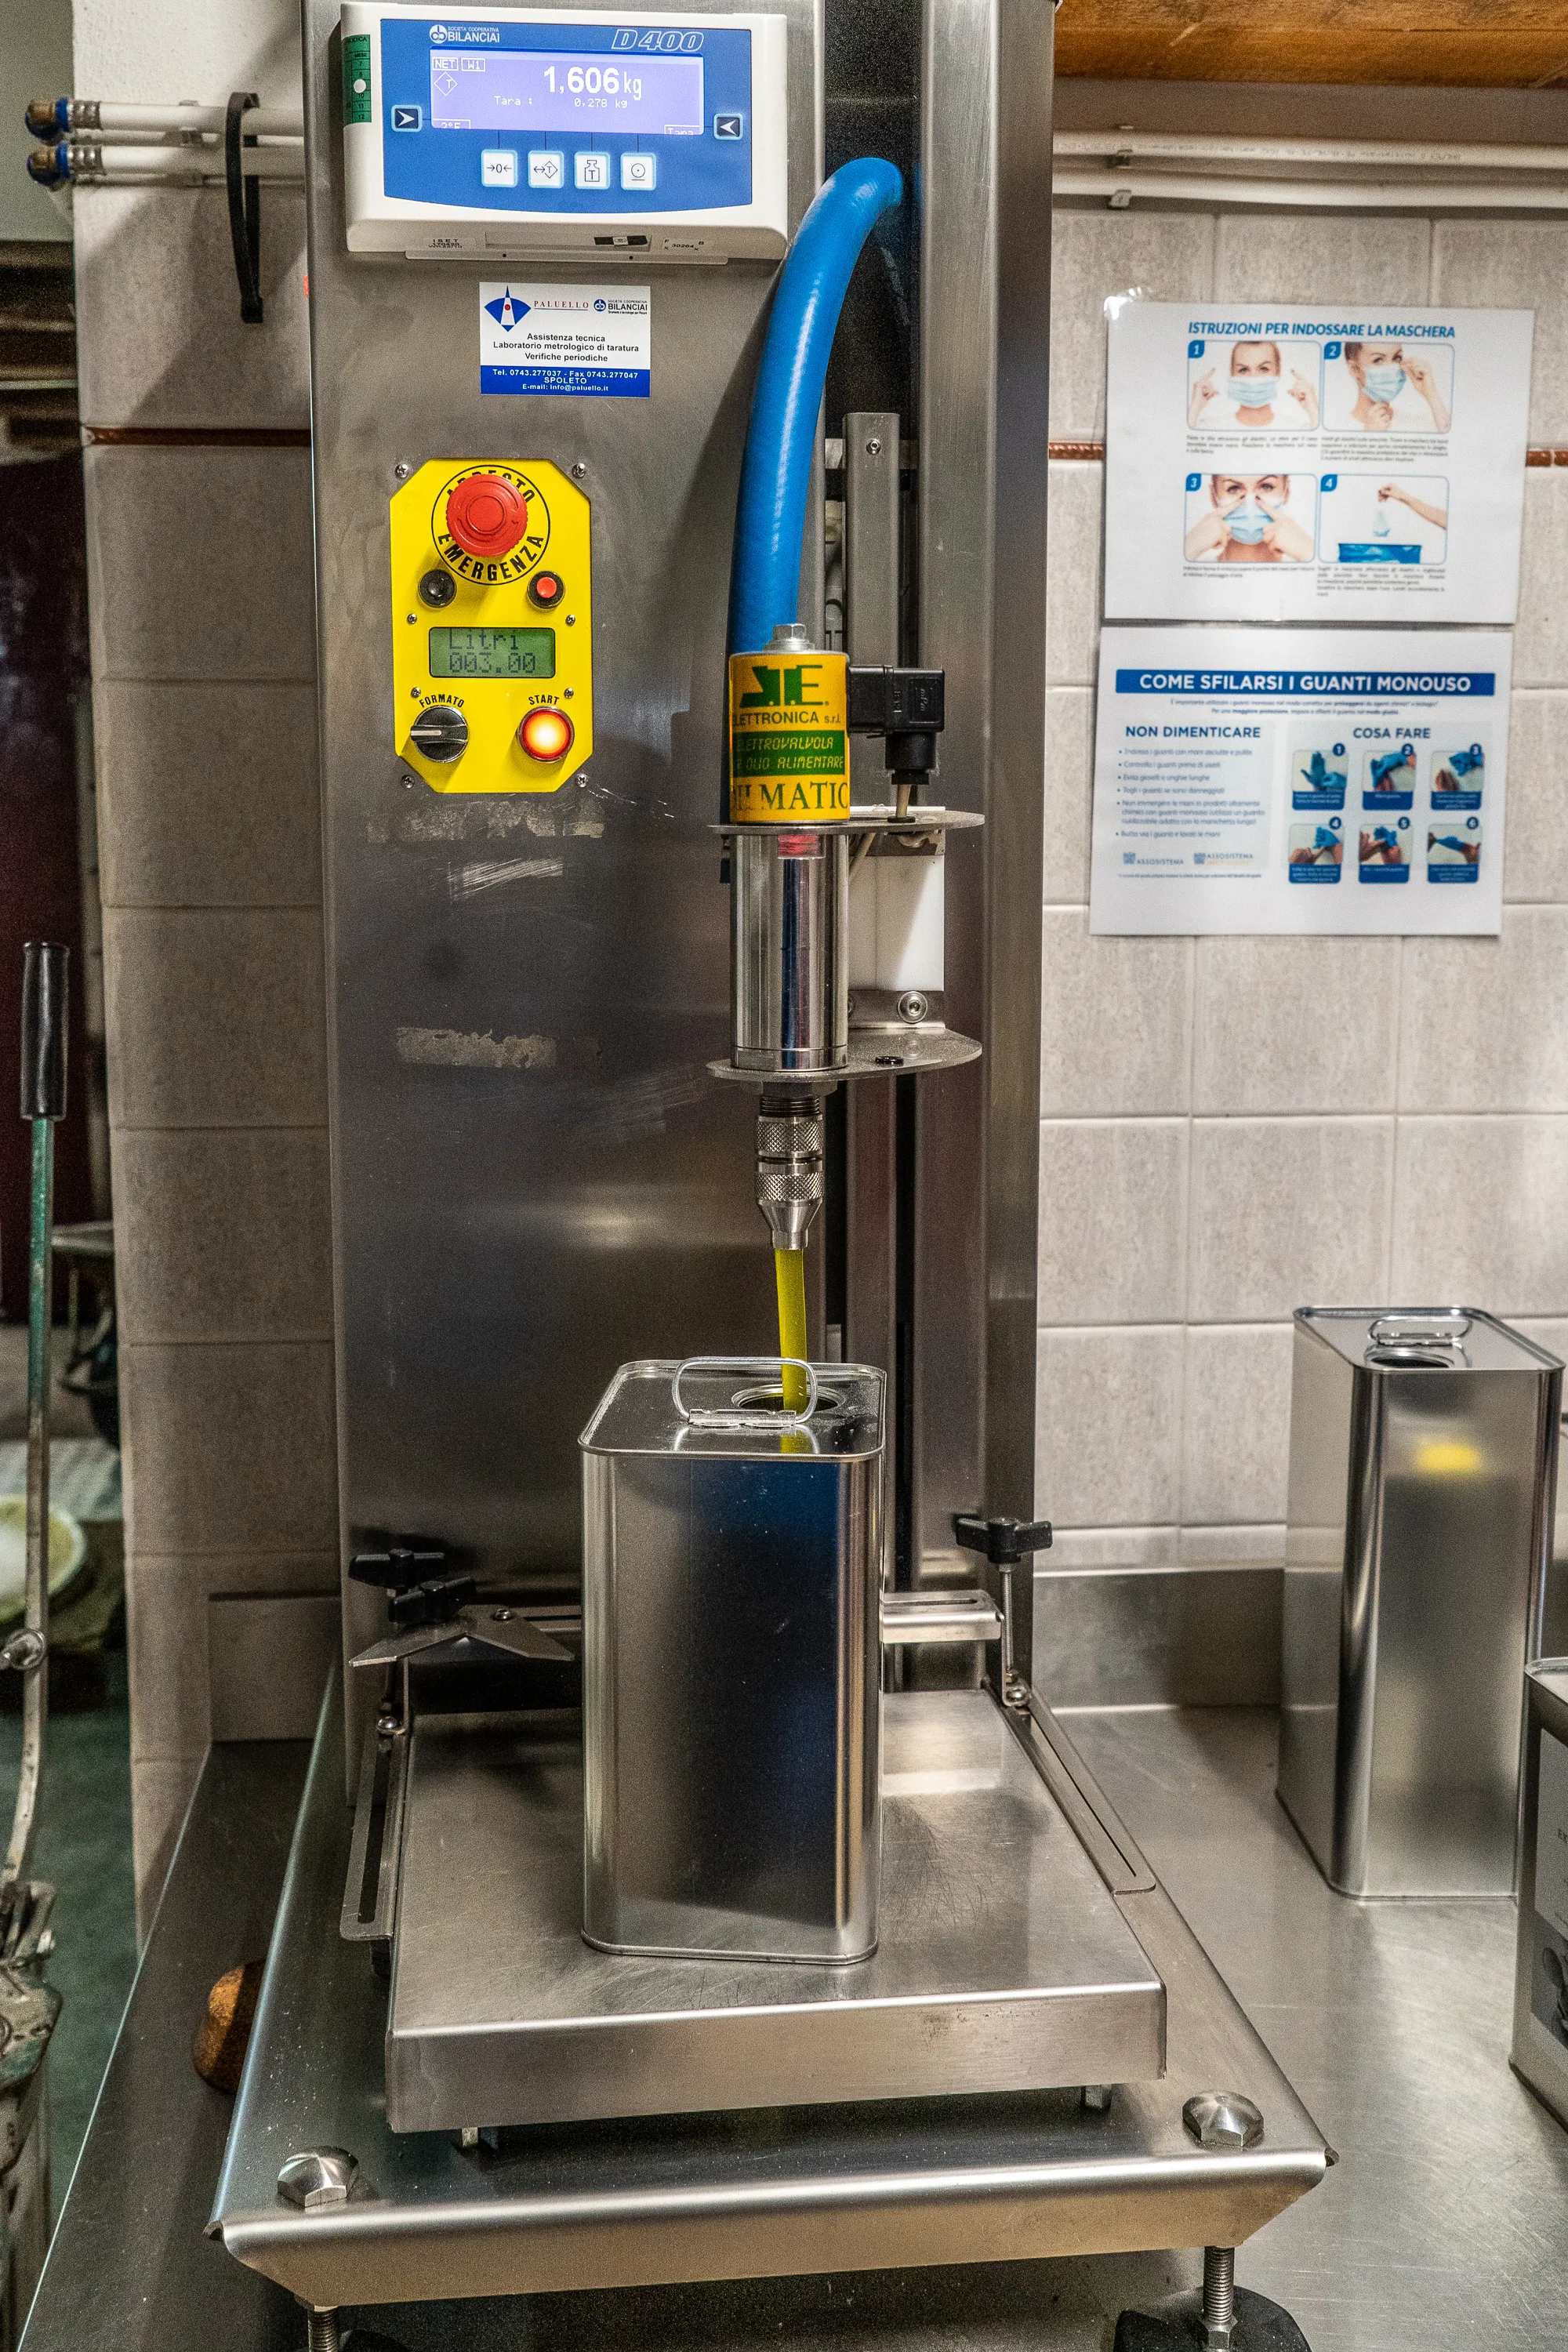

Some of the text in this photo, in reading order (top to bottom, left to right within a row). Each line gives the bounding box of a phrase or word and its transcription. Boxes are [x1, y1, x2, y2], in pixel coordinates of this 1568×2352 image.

[448, 32, 499, 43] BILANCIAI
[435, 59, 456, 69] NET
[467, 60, 481, 69] W1
[543, 65, 642, 100] 1,606 kg
[494, 96, 521, 106] Tara
[574, 98, 608, 108] 0,278
[615, 99, 628, 109] kg
[1188, 321, 1456, 338] ISTRUZIONI PER INDOSSARE LA MASCHERA
[527, 333, 573, 342] Assistenza
[493, 341, 542, 350] Laboratorio
[544, 343, 594, 352] metrologico
[1192, 345, 1200, 355] 1
[1328, 343, 1338, 356] 2
[524, 352, 608, 363] Verifiche periodiche
[1190, 477, 1198, 488] 3
[1325, 478, 1334, 488] 4
[437, 534, 544, 582] EMERGENZA
[448, 628, 519, 650] Litri
[448, 652, 536, 674] 003.00
[1139, 673, 1472, 692] COME SFILARSI I GUANTI MONOUSO
[419, 694, 465, 709] FORMATO
[528, 695, 560, 706] START
[1125, 726, 1261, 738] NON DIMENTICARE
[1352, 728, 1431, 739] COSA FARE
[746, 757, 771, 771] OLIO
[777, 756, 844, 770] ALIMENTARE
